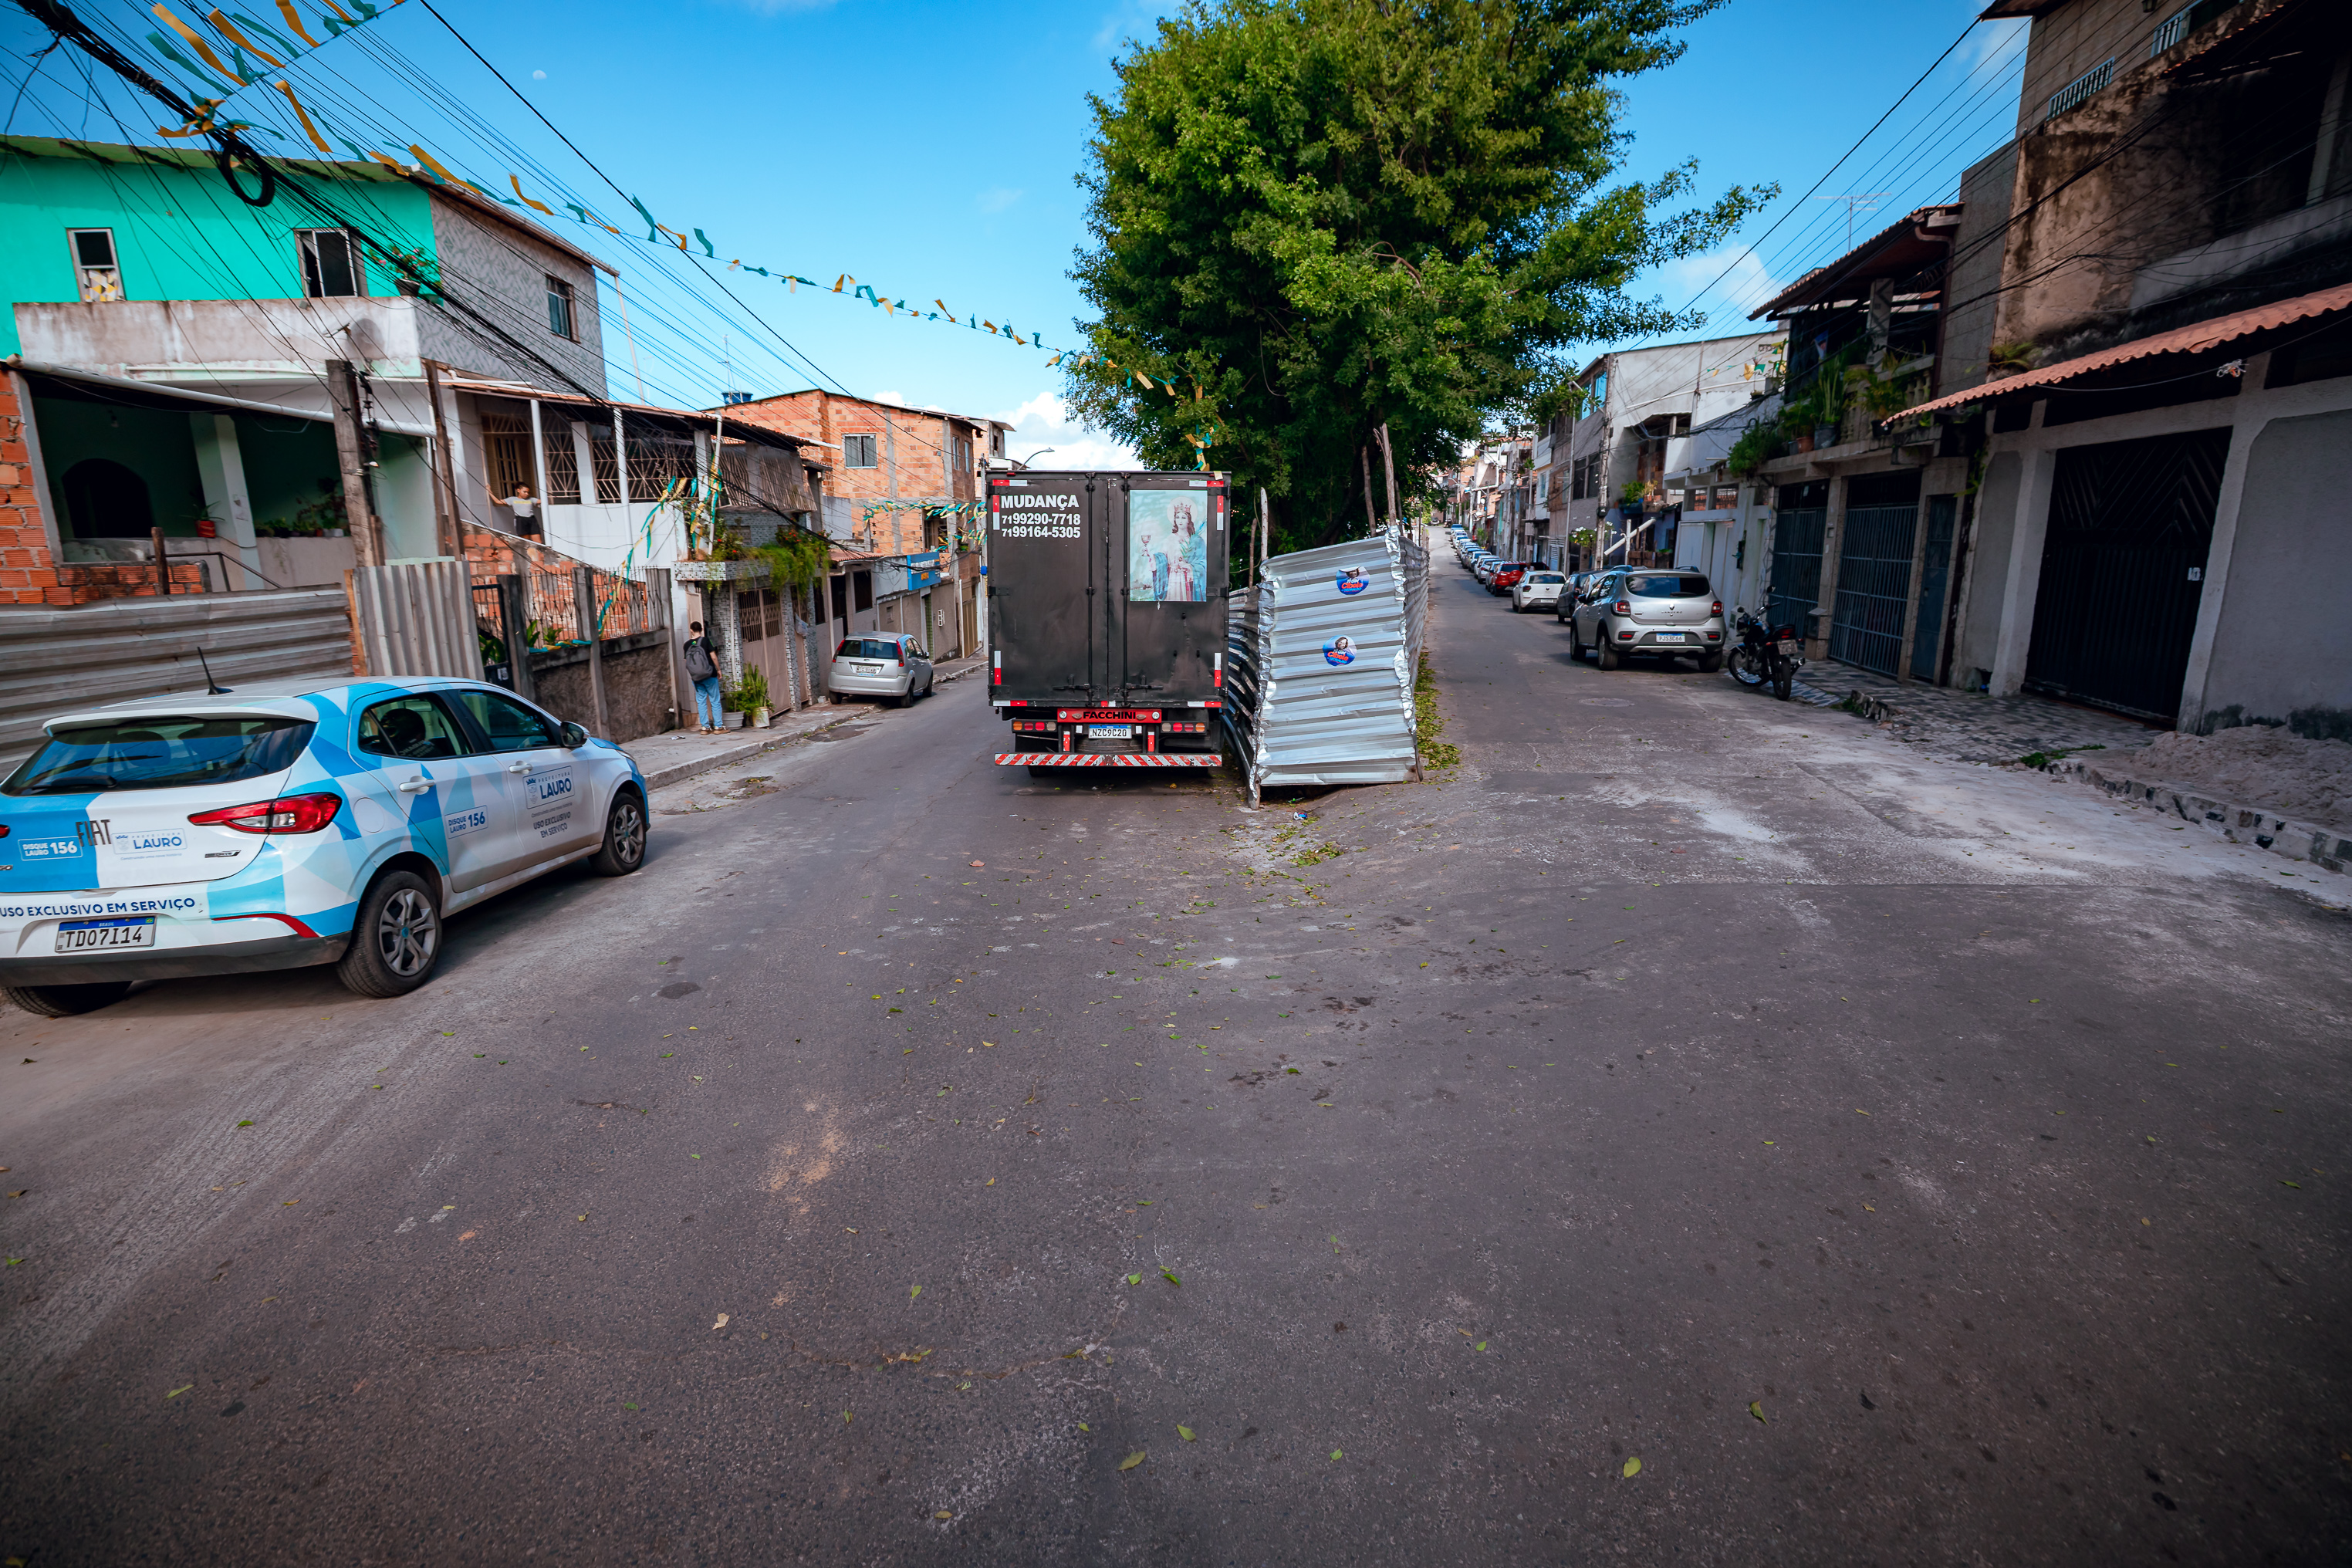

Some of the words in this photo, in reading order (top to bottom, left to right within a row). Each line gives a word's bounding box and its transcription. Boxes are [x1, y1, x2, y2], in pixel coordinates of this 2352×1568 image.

[1001, 495, 1080, 511] MUDANÇA
[538, 772, 570, 782] PREFEITURA
[539, 778, 572, 799] LAURO
[448, 816, 466, 826] DISQUE
[468, 811, 485, 827] 156
[533, 819, 544, 830] USO
[545, 811, 571, 826] EXCLUSIVO
[76, 819, 112, 847] FIAT
[450, 823, 466, 833] LAURO
[540, 829, 549, 838] EM
[548, 823, 568, 835] SERVIÇO
[49, 841, 78, 854] 156
[133, 836, 182, 849] LAURO
[0, 907, 24, 917] USO
[28, 904, 103, 917] EXCLUSIVO
[107, 902, 127, 913] EM
[131, 897, 195, 911] SERVIÇO
